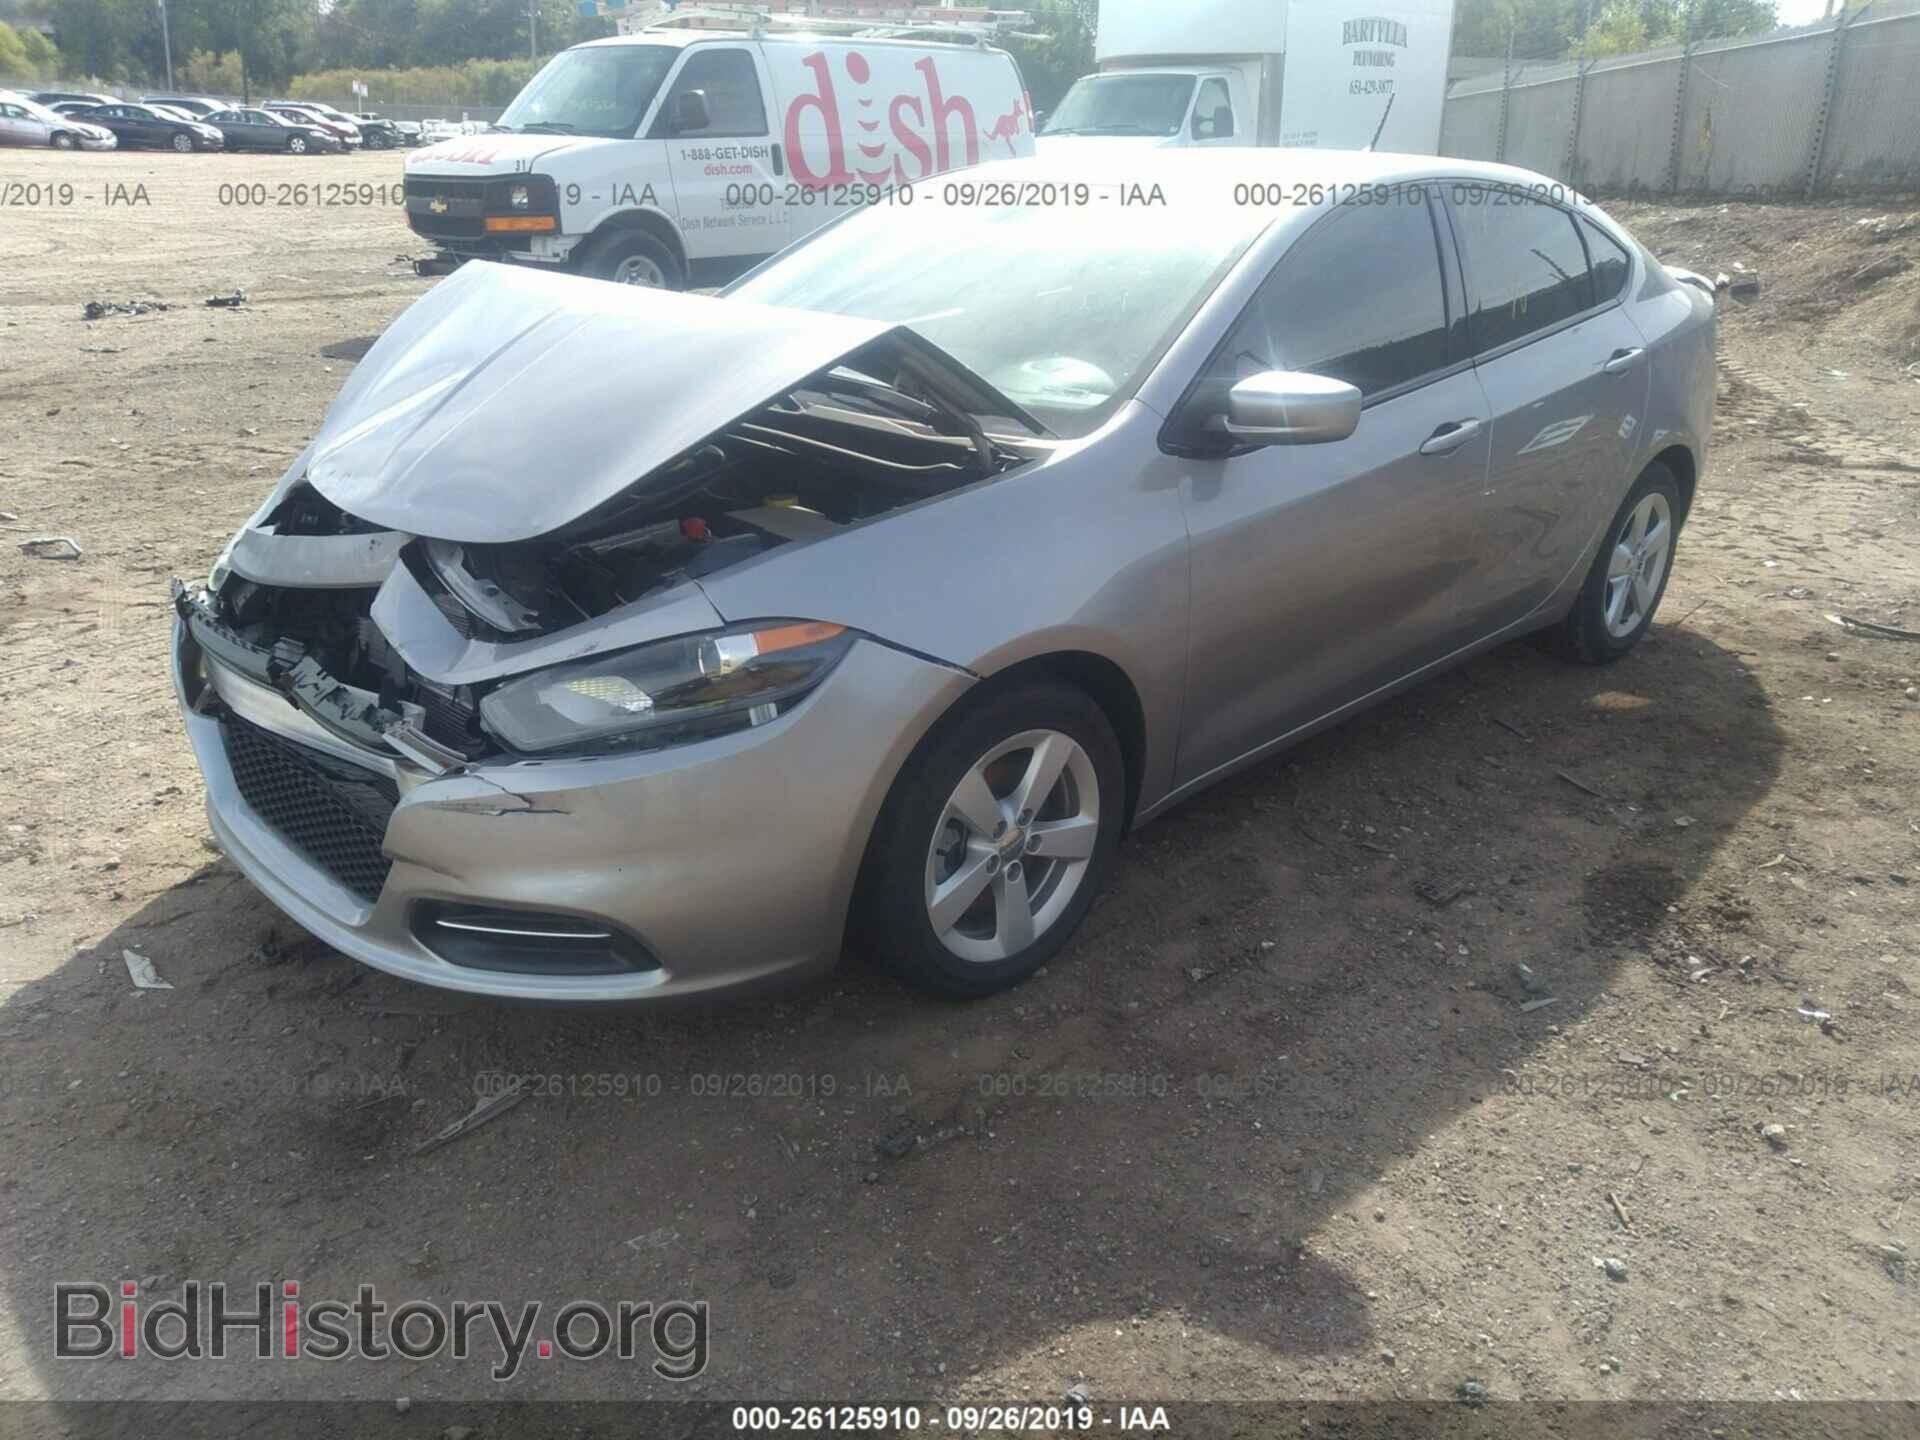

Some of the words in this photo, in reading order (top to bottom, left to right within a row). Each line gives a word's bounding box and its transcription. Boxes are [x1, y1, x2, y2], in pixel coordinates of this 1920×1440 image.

[784, 51, 978, 193] dish
[680, 146, 769, 161] 1-888-GET-DISH
[703, 164, 753, 177] dish.com
